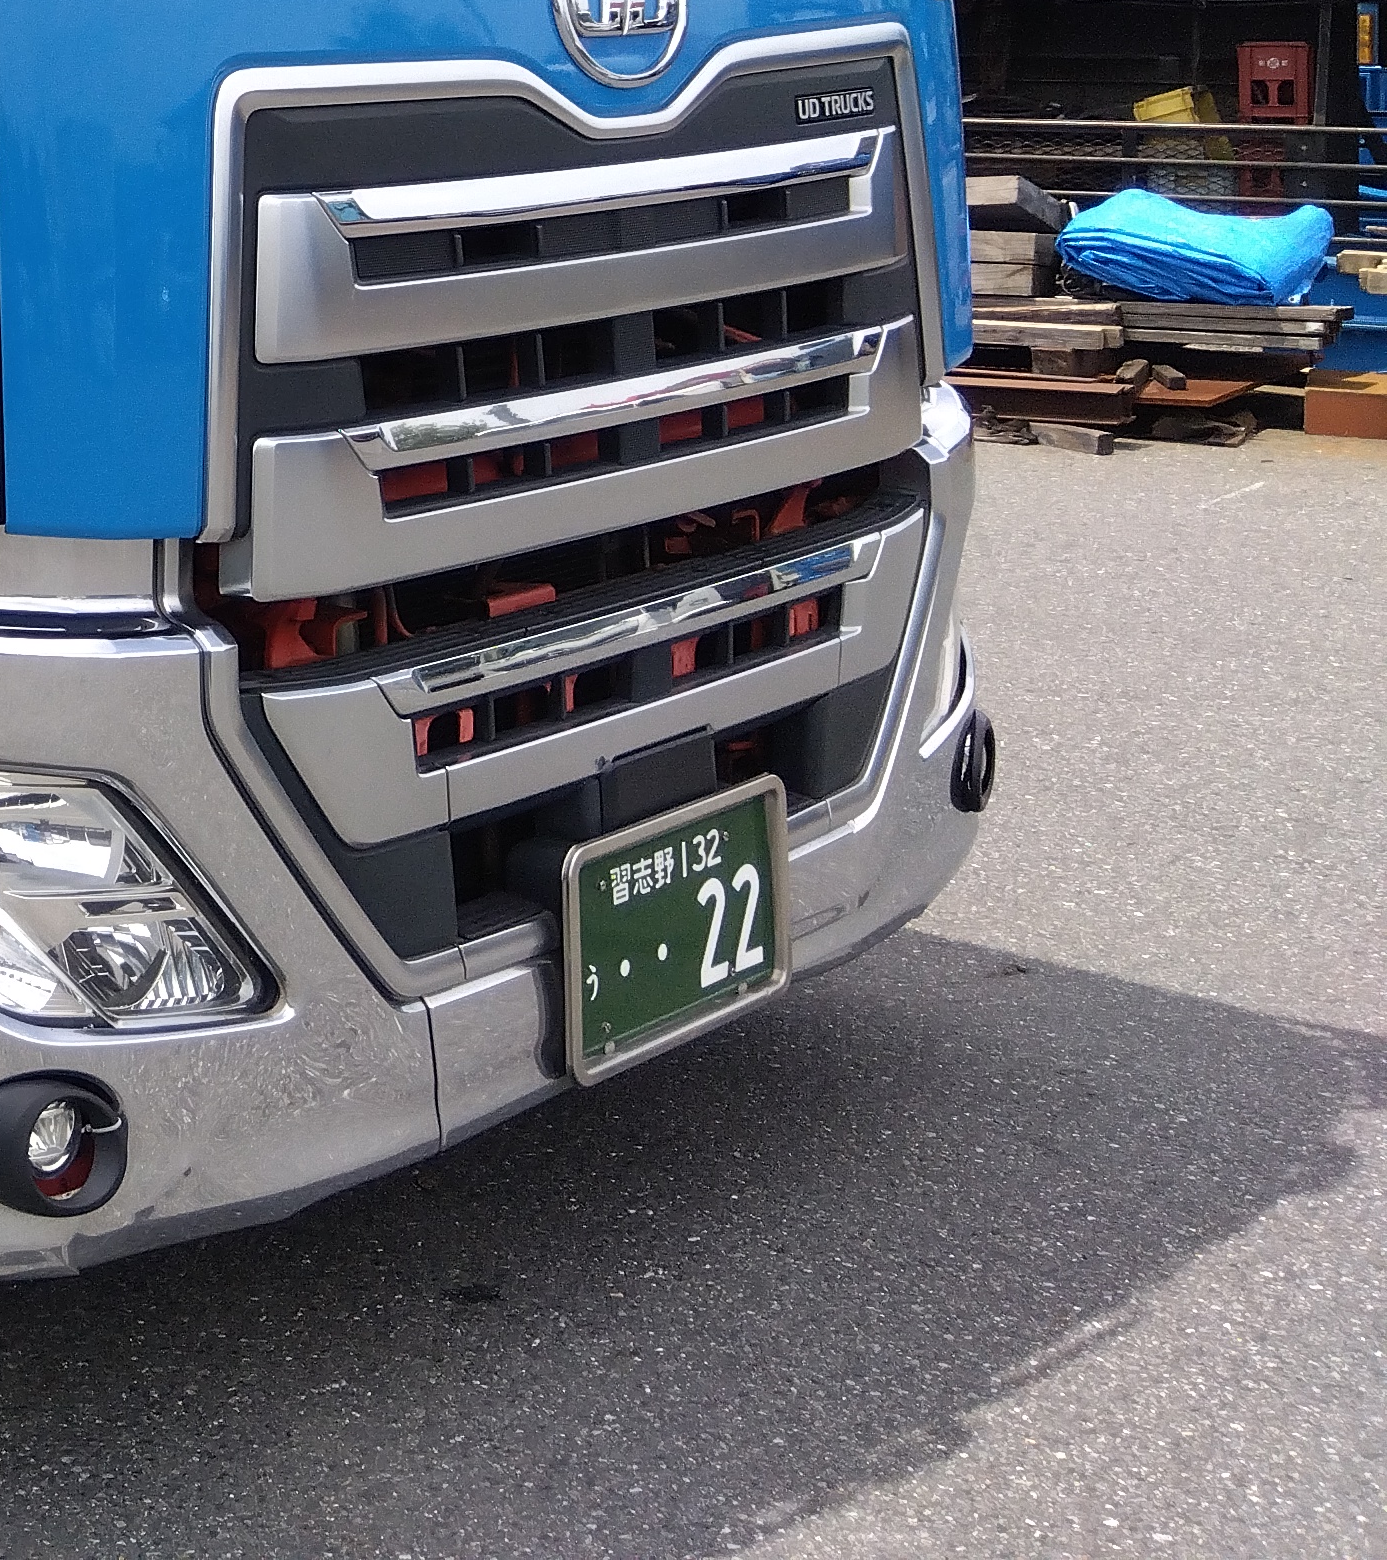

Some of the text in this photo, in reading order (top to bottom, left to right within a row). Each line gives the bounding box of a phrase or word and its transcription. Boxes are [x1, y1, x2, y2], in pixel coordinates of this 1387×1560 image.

[797, 90, 874, 120] UD TRUCKS
[609, 828, 722, 906] 習志野 132
